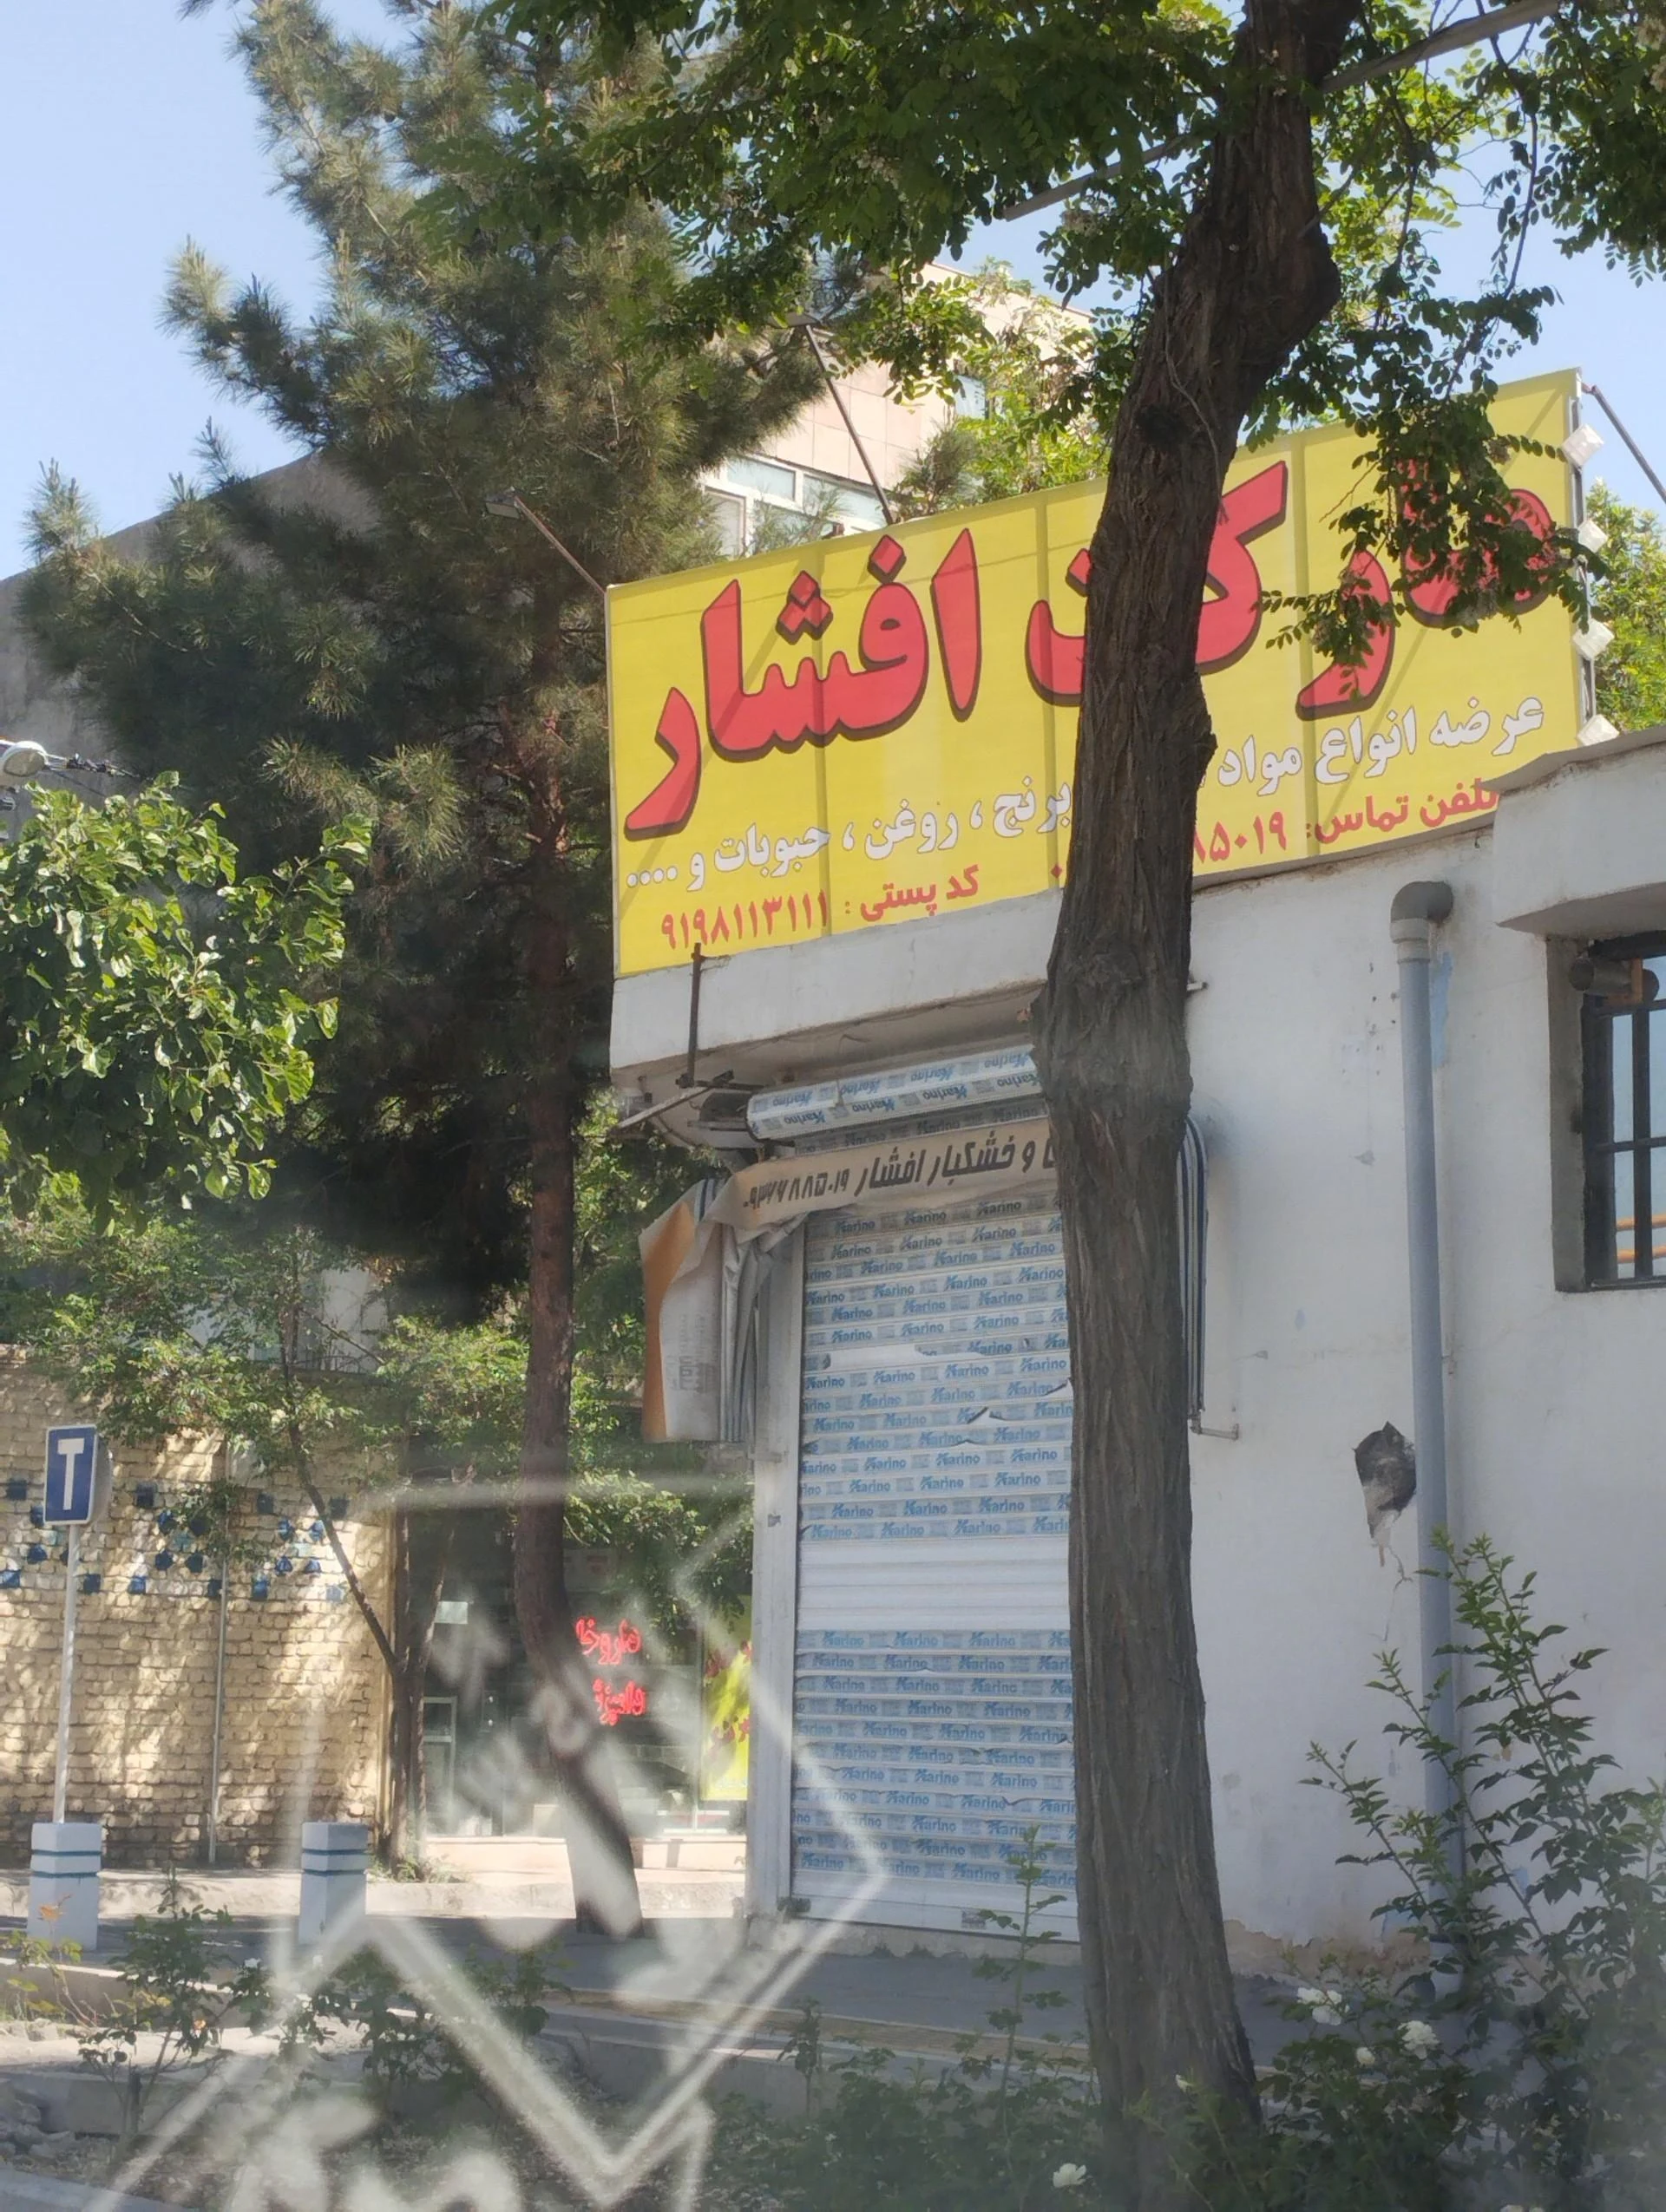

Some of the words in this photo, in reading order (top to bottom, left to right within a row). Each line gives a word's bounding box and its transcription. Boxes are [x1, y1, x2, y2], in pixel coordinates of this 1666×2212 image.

[624, 527, 982, 841] افشار
[1314, 705, 1416, 784] انواع
[1430, 697, 1544, 756] عرضه
[1217, 735, 1302, 797] مواد
[864, 798, 959, 860] روغن
[993, 776, 1072, 837] برنج
[686, 852, 705, 892] و
[714, 822, 831, 878] حبوبات
[860, 883, 937, 921] پستی
[946, 864, 979, 900] کد
[661, 889, 827, 950] ۹۱۹۸۱۱۳۱۱۱
[854, 1146, 926, 1197] افشار
[927, 1130, 1016, 1187] خشکبار
[1021, 1140, 1035, 1173] و
